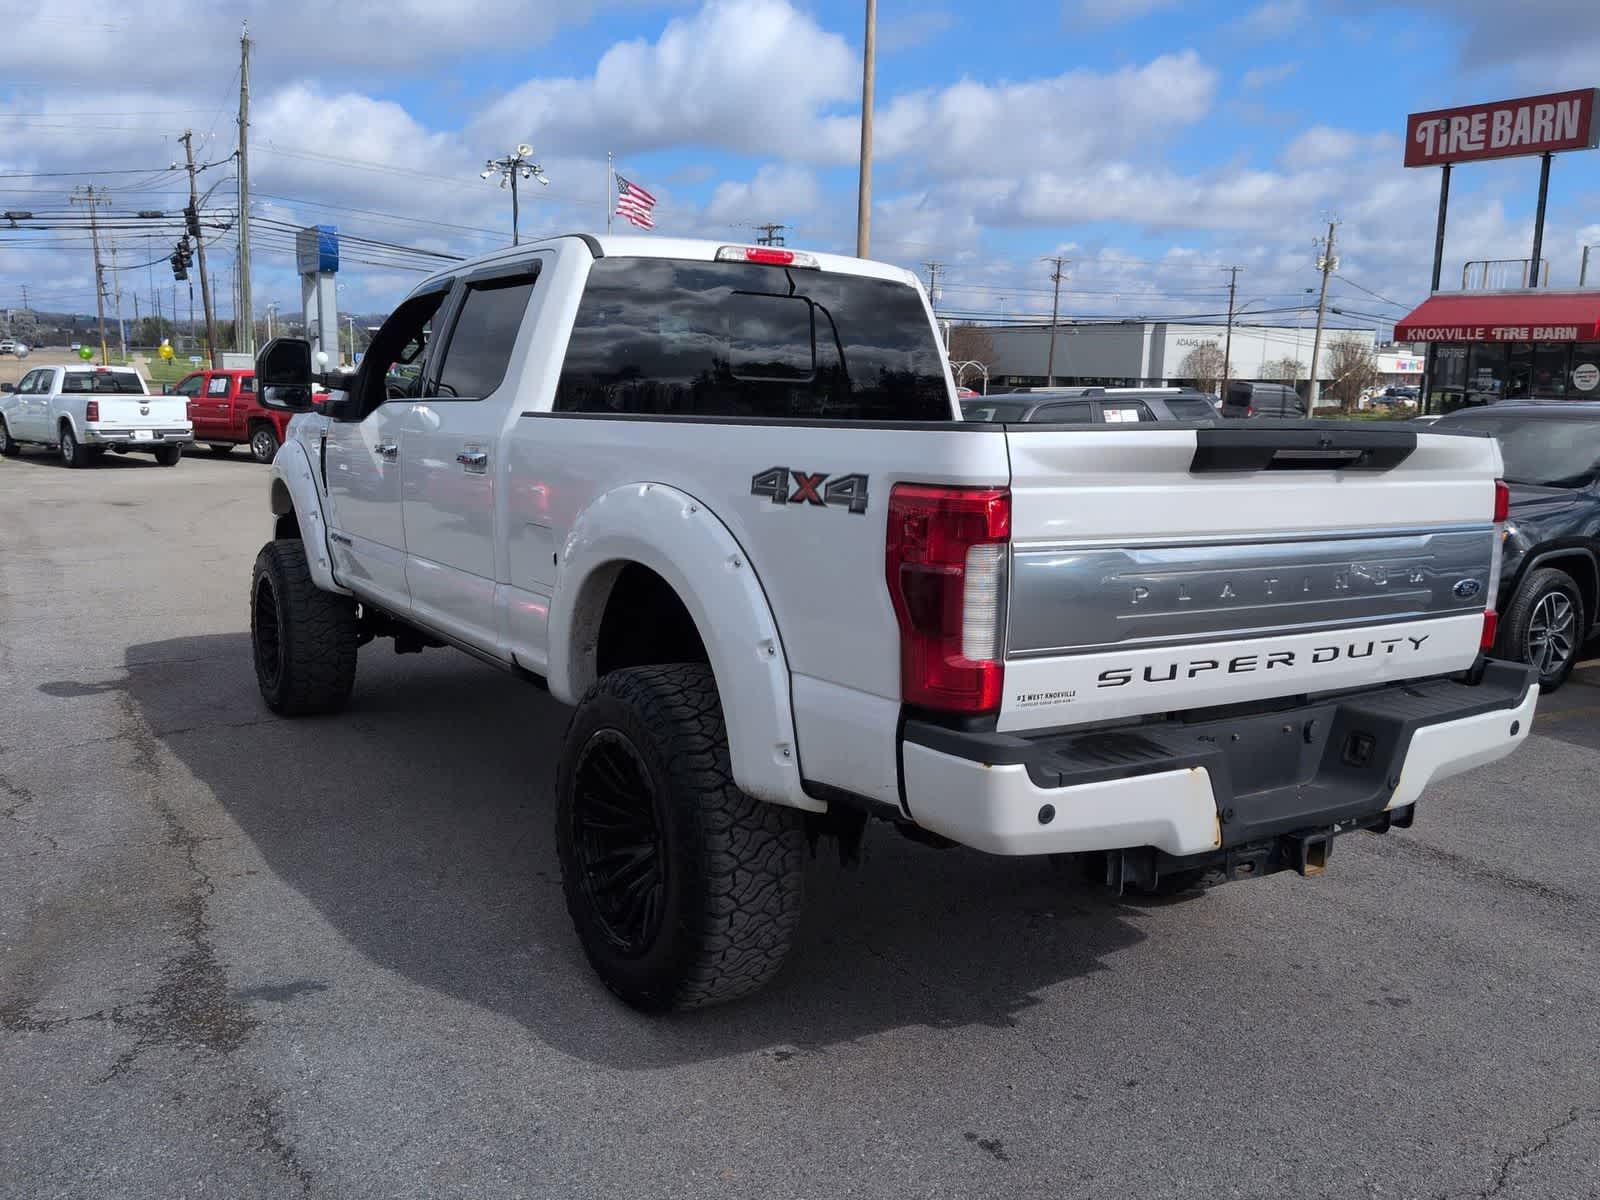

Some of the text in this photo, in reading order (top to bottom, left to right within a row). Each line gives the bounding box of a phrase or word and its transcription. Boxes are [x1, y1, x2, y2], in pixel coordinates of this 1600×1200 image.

[1490, 99, 1581, 149] BARN
[1407, 327, 1484, 340] KNOXVILLE
[1532, 327, 1577, 340] BARN
[1131, 565, 1425, 604] PLATINUM
[1097, 634, 1430, 688] SUPER DUTY
[1027, 693, 1044, 701] WEST
